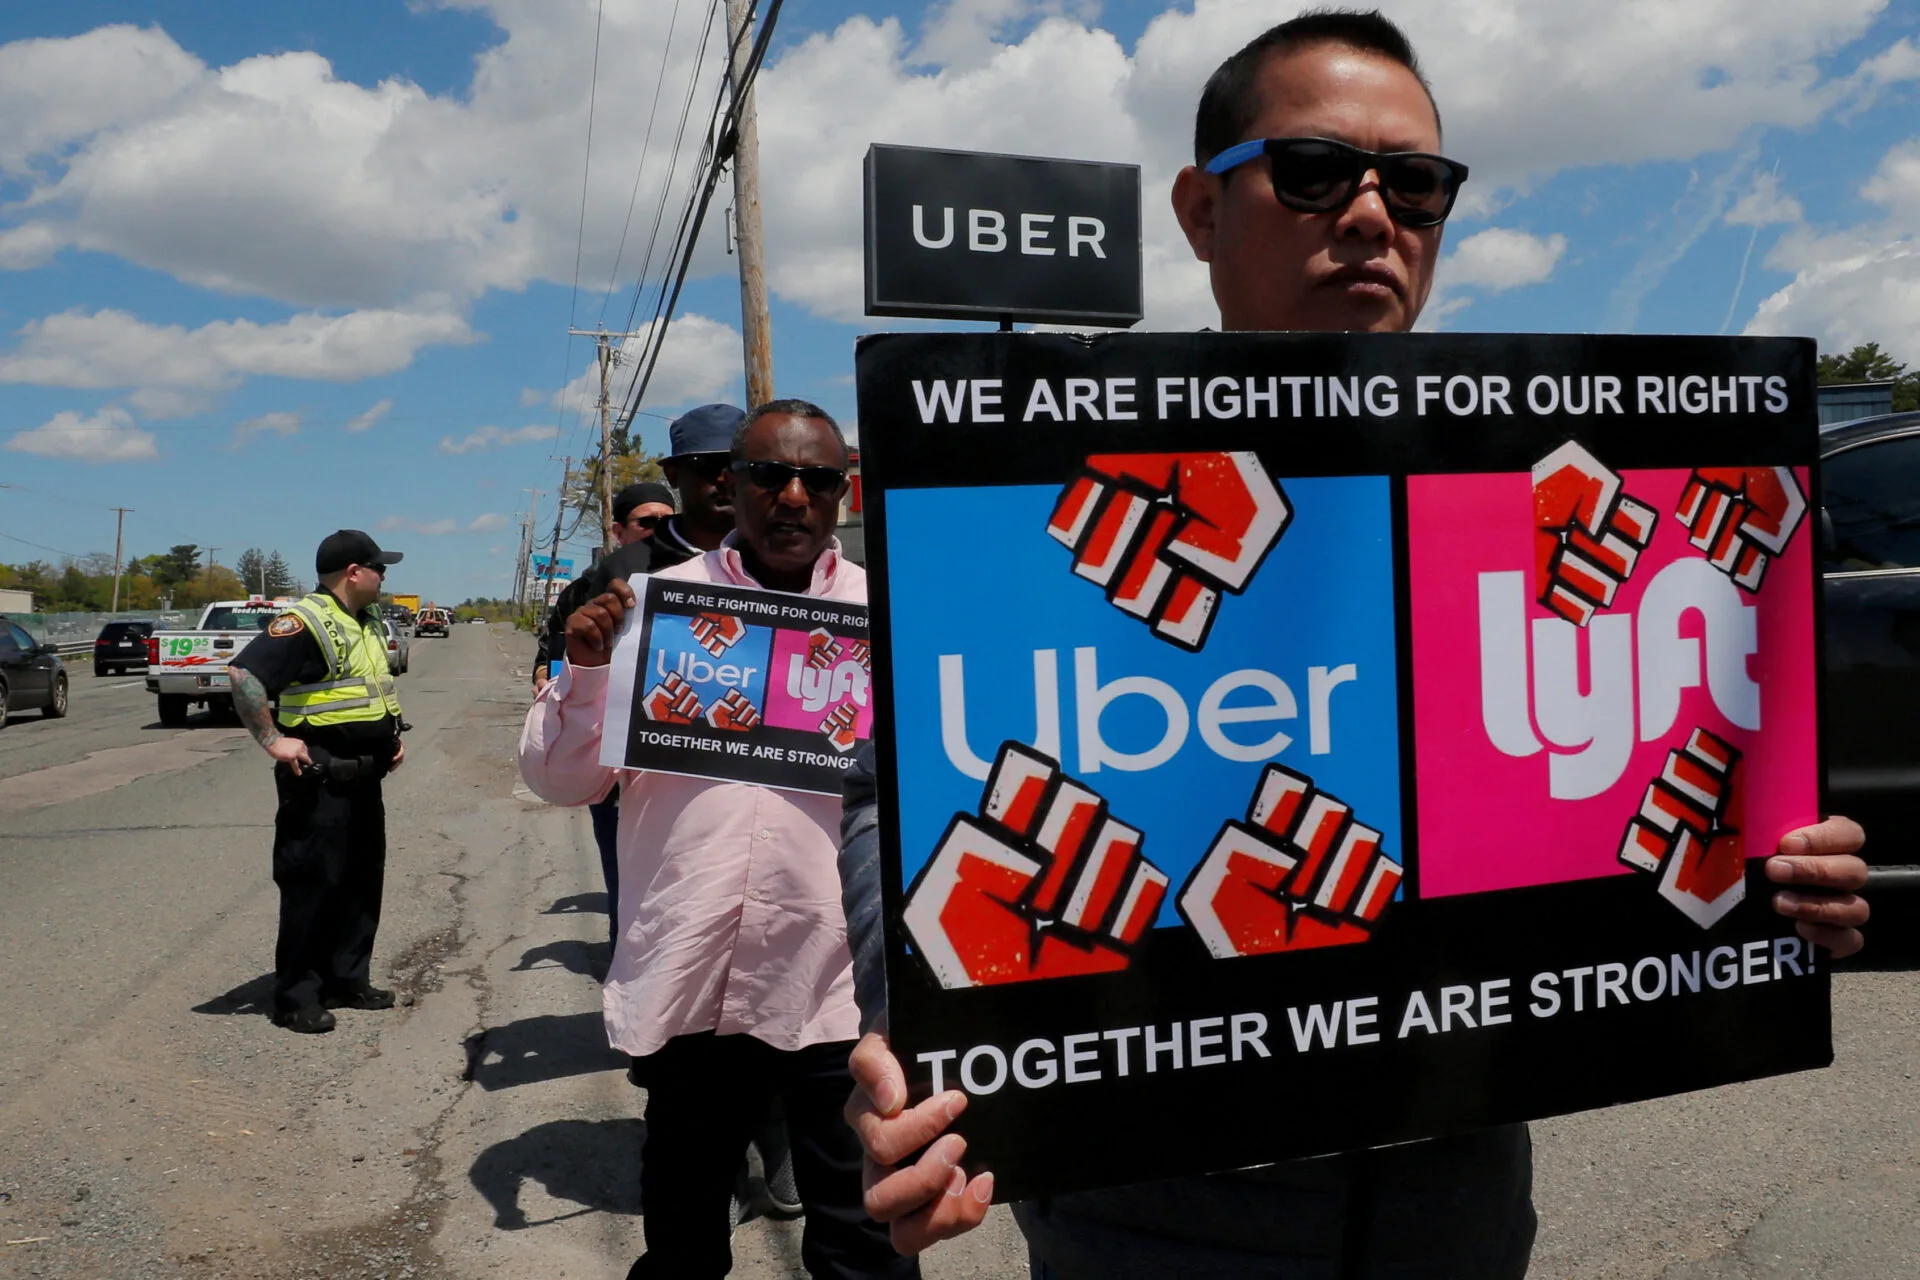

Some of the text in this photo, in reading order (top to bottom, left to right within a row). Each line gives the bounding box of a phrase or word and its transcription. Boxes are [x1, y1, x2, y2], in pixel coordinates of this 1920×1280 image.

[912, 204, 1107, 259] UBER
[911, 375, 1789, 424] WE ARE FIGHTING FOR OUR RIGHTS
[662, 591, 684, 604] WE
[687, 594, 715, 608] ARE
[717, 598, 779, 616] FIGHTING
[781, 606, 808, 620] FOR
[811, 610, 839, 624] OUR
[656, 648, 757, 688] Uber
[786, 653, 870, 713] lyft
[1478, 556, 1761, 800] lyft
[939, 646, 1357, 783] Uber
[638, 730, 722, 753] TOGETHER
[726, 742, 750, 756] WE
[752, 745, 784, 762] ARE
[916, 936, 1816, 1096] TOGETHER WE ARE STRONGER!
